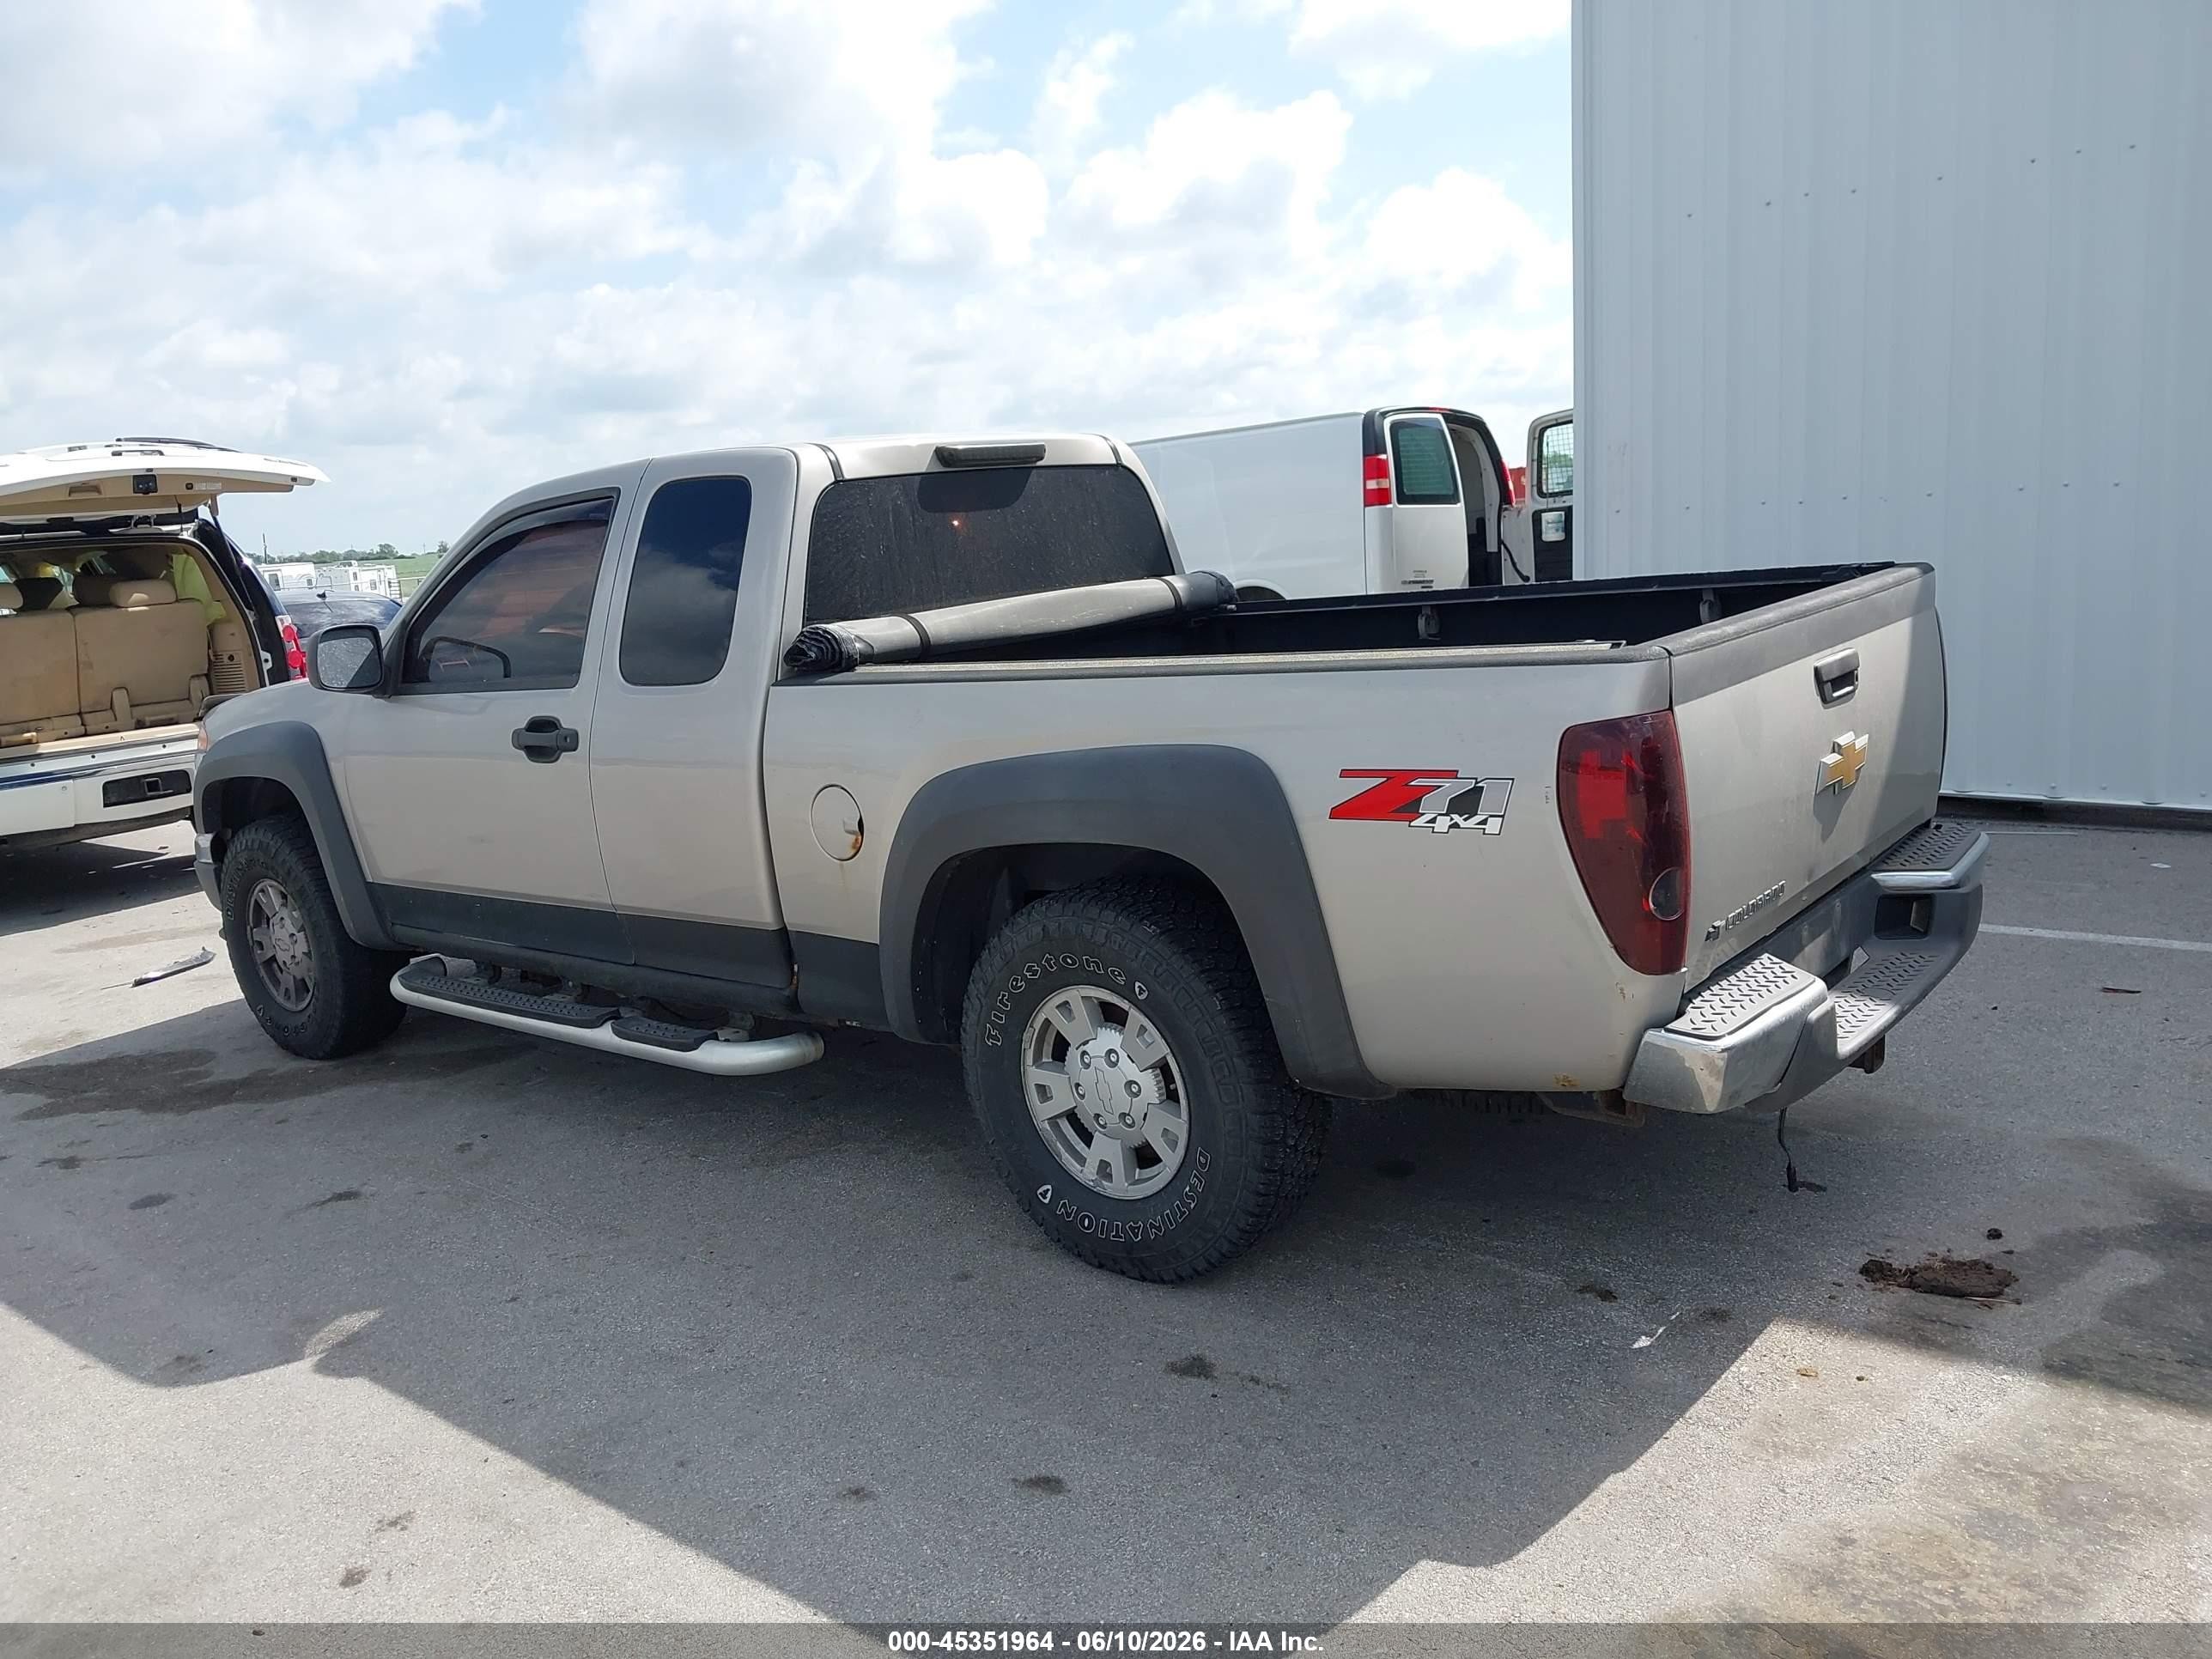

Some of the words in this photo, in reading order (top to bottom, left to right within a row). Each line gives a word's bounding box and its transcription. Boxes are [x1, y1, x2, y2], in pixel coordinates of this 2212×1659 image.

[1328, 769, 1515, 823] Z71
[984, 953, 1127, 1047] Firestone
[1056, 1147, 1212, 1242] DESTINATION
